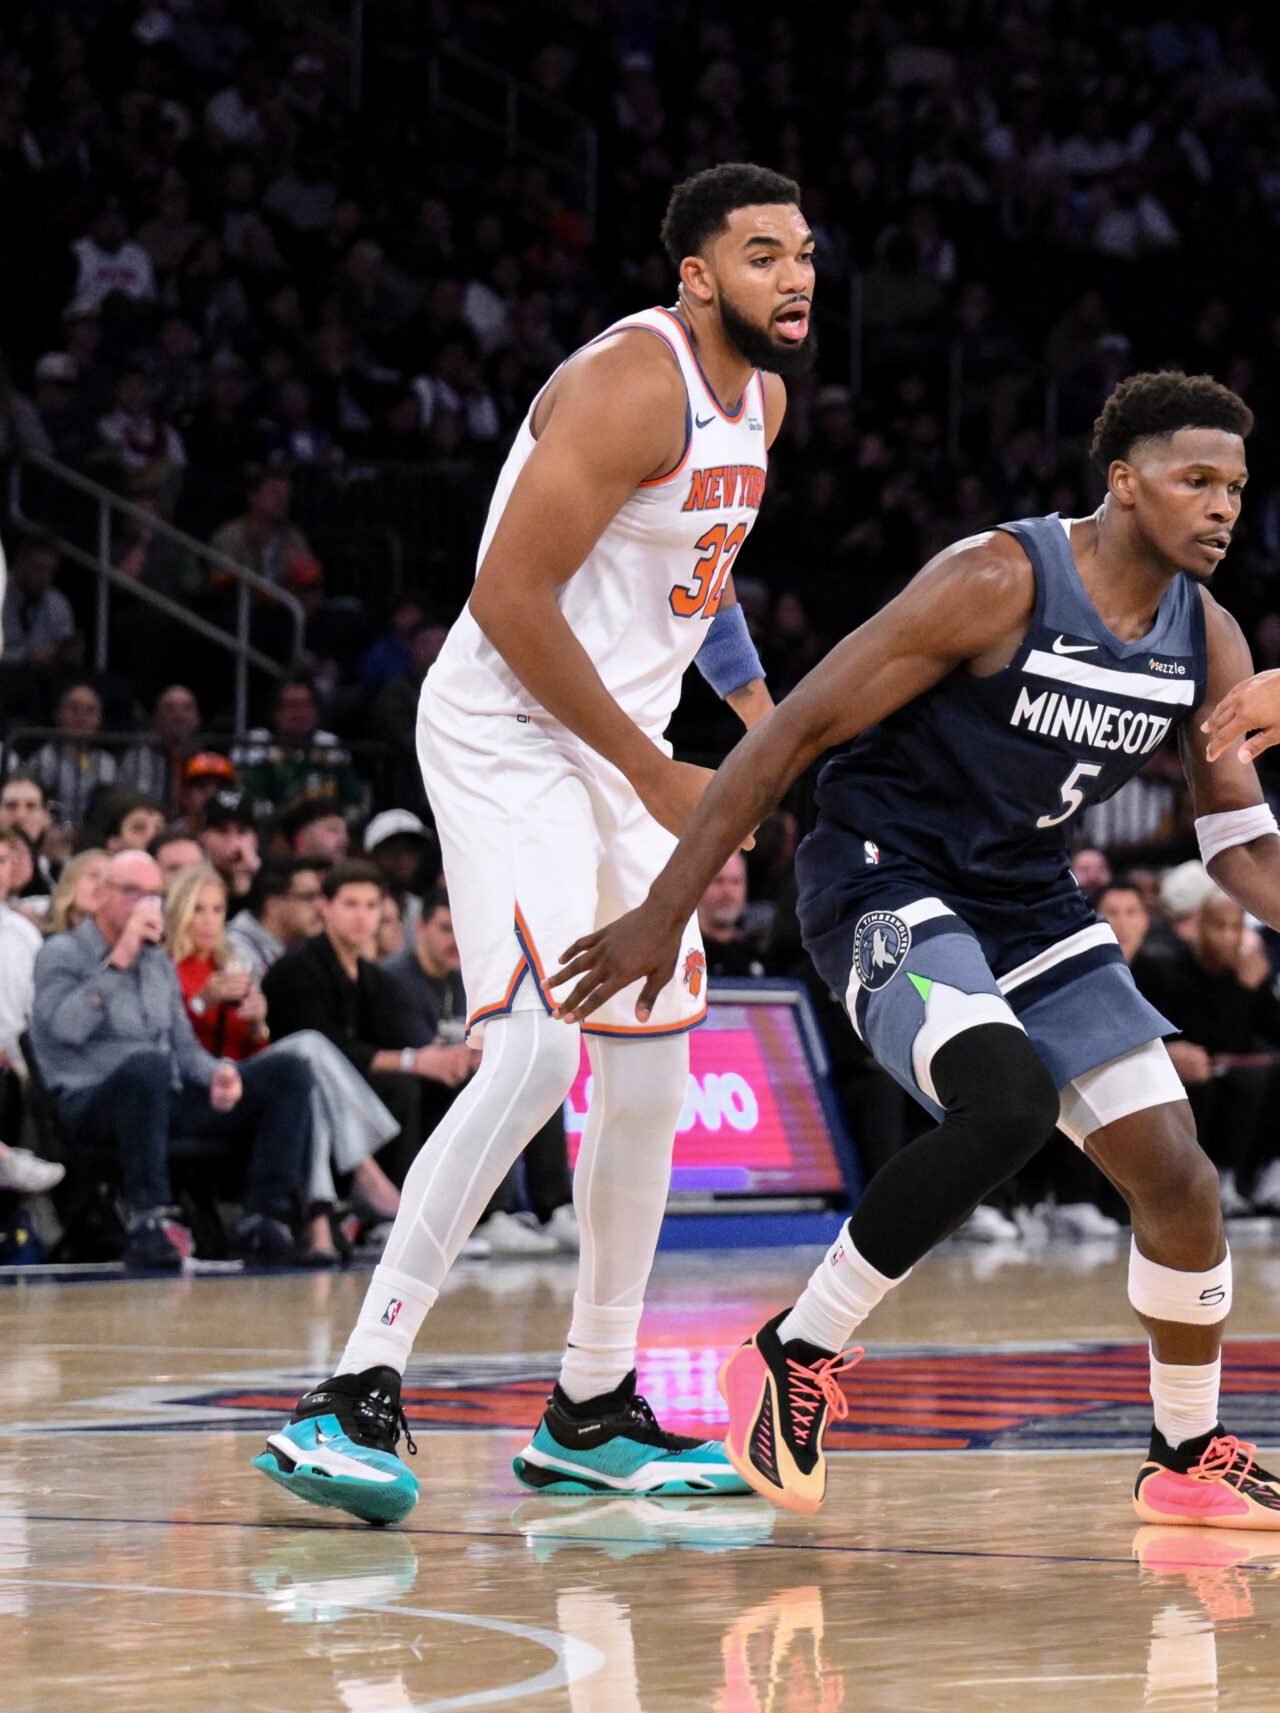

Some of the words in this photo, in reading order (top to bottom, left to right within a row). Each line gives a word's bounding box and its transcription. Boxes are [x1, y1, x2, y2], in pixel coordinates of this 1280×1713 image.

[681, 465, 739, 512] NEW
[669, 522, 748, 620] 32
[1155, 661, 1187, 675] sezzle
[1036, 760, 1103, 829] 5
